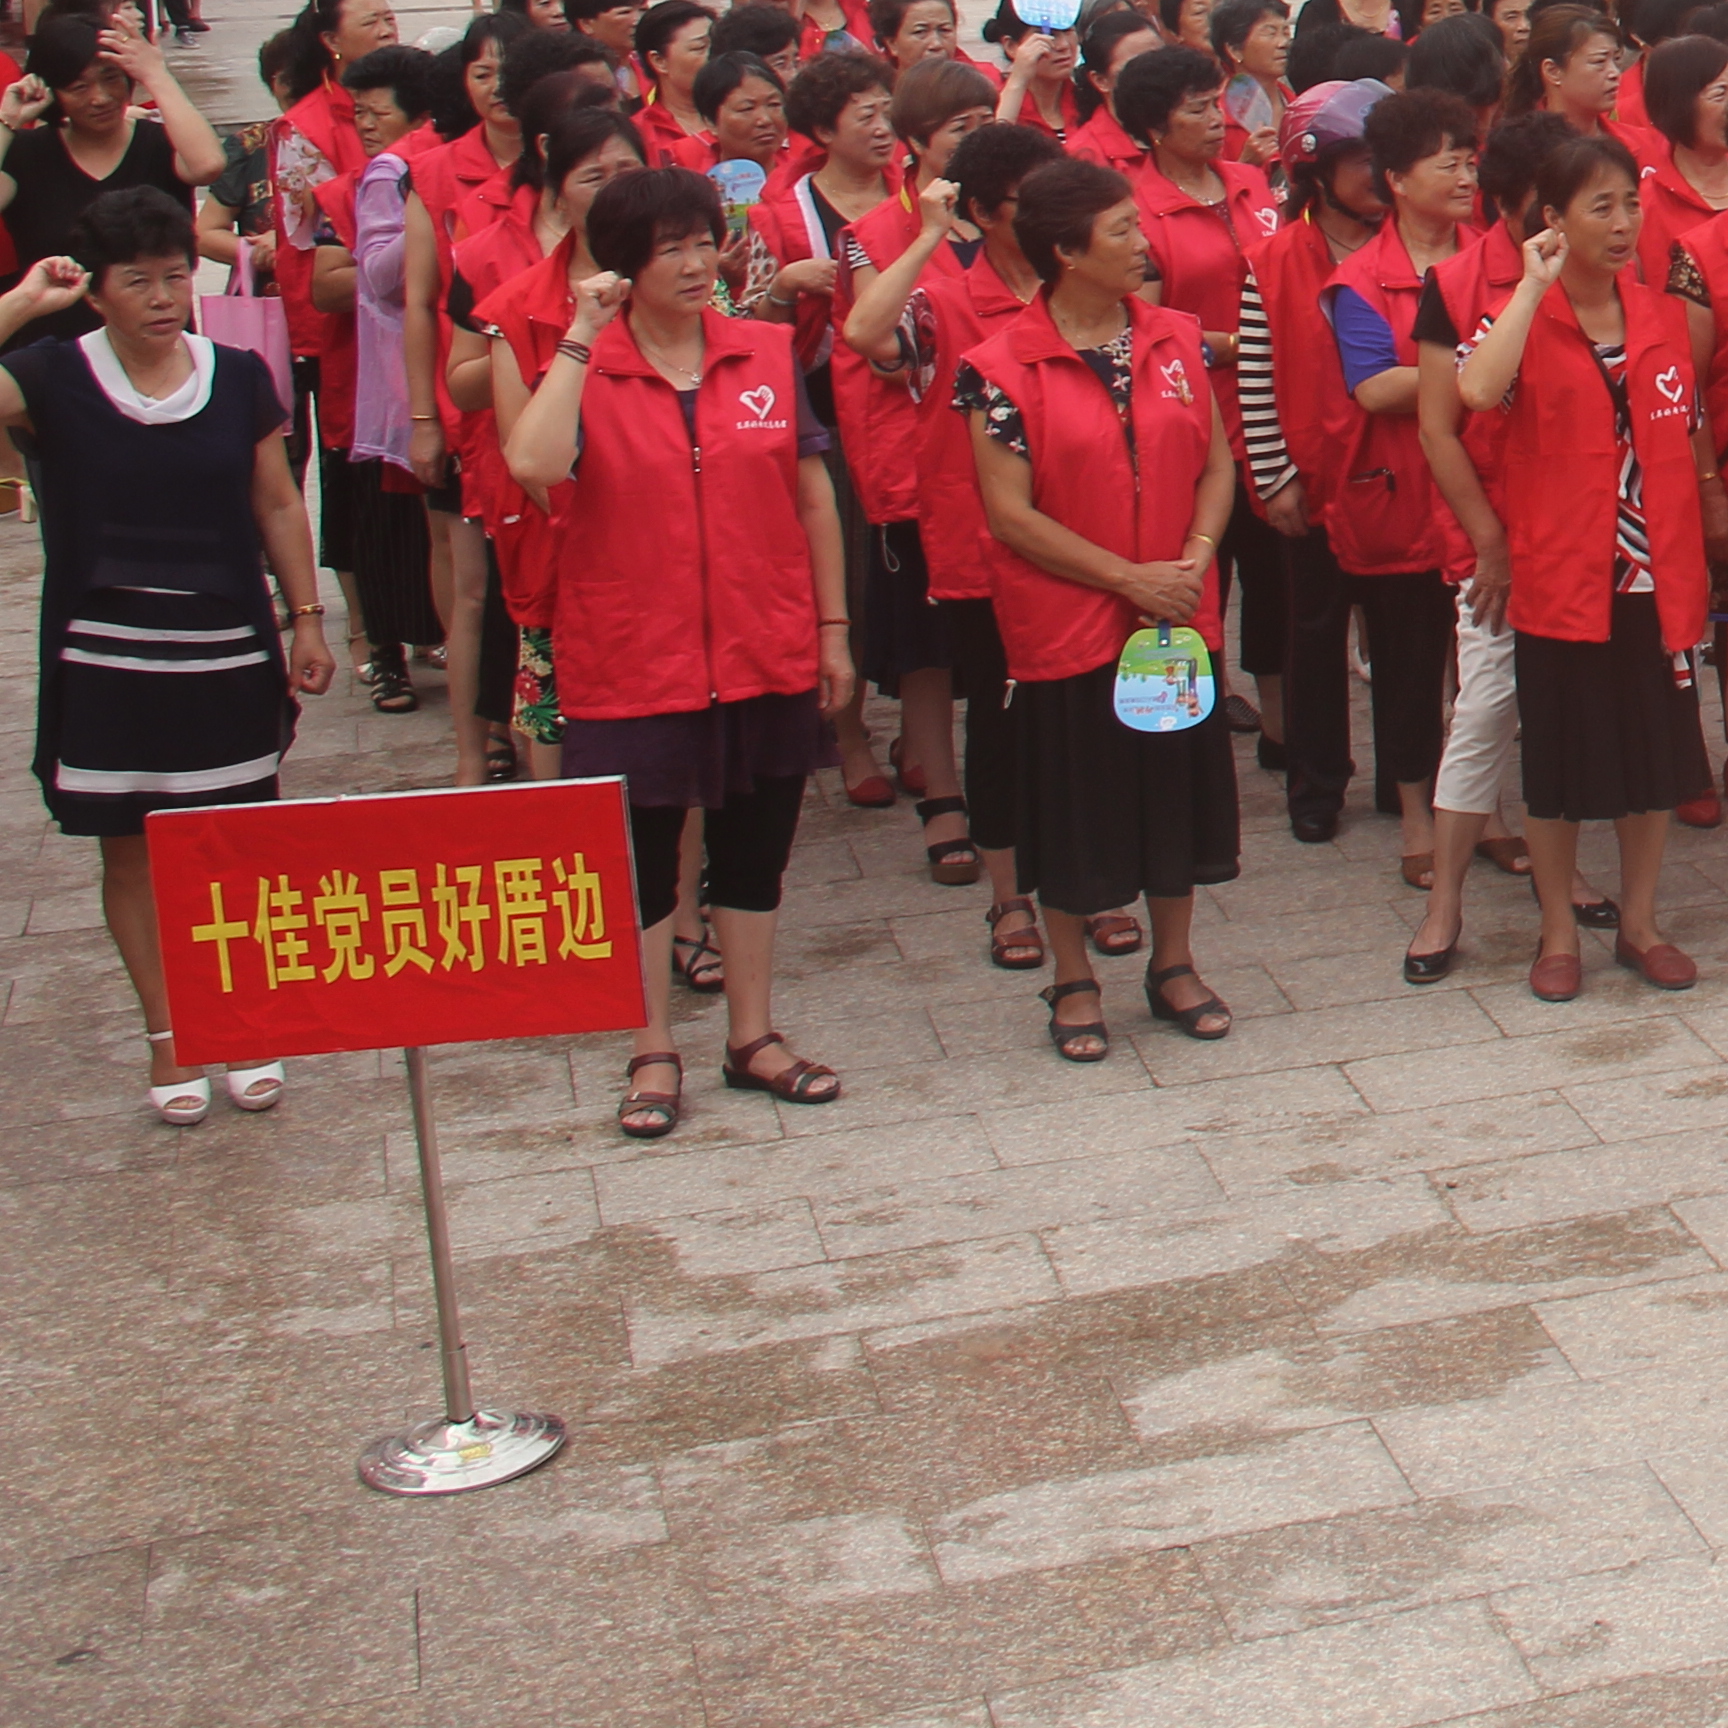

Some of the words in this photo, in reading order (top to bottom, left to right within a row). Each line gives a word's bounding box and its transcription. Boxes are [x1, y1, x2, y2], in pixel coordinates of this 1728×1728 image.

[191, 851, 613, 994] 十佳党员好厝边
